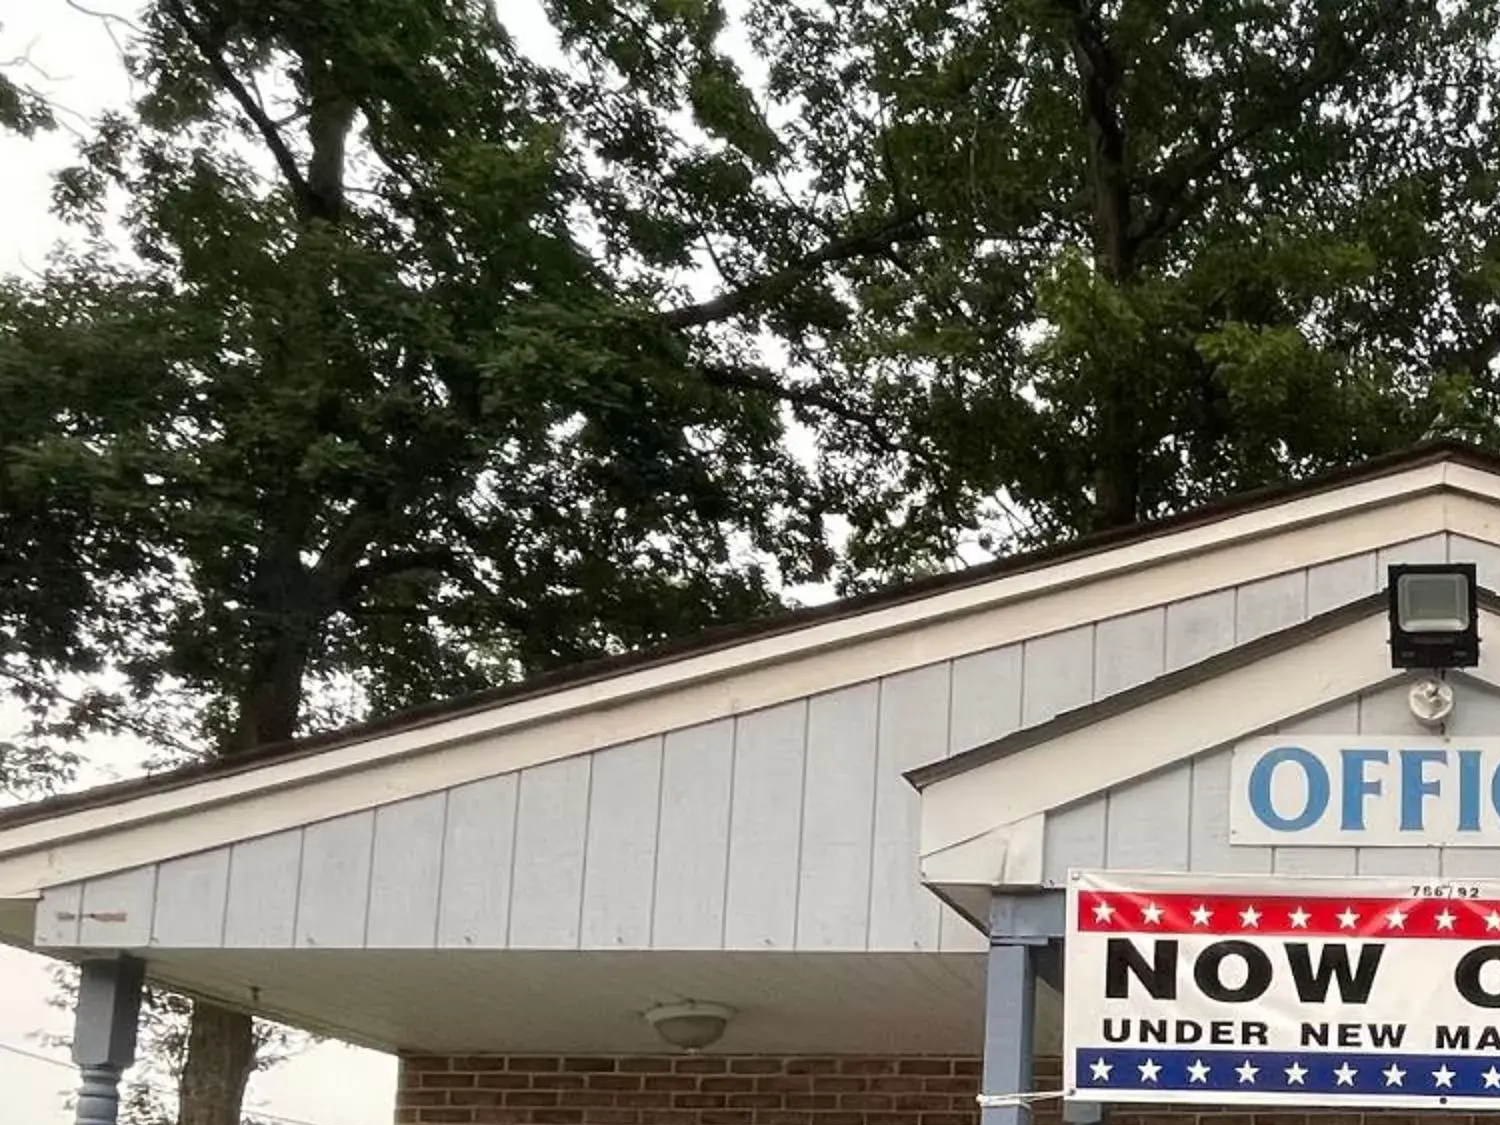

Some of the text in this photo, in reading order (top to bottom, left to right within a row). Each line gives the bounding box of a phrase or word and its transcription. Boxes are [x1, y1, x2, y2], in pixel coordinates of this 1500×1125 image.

[1106, 938, 1385, 1004] NOW
[1102, 1018, 1268, 1045] UNDER
[1300, 1023, 1407, 1049] NEW
